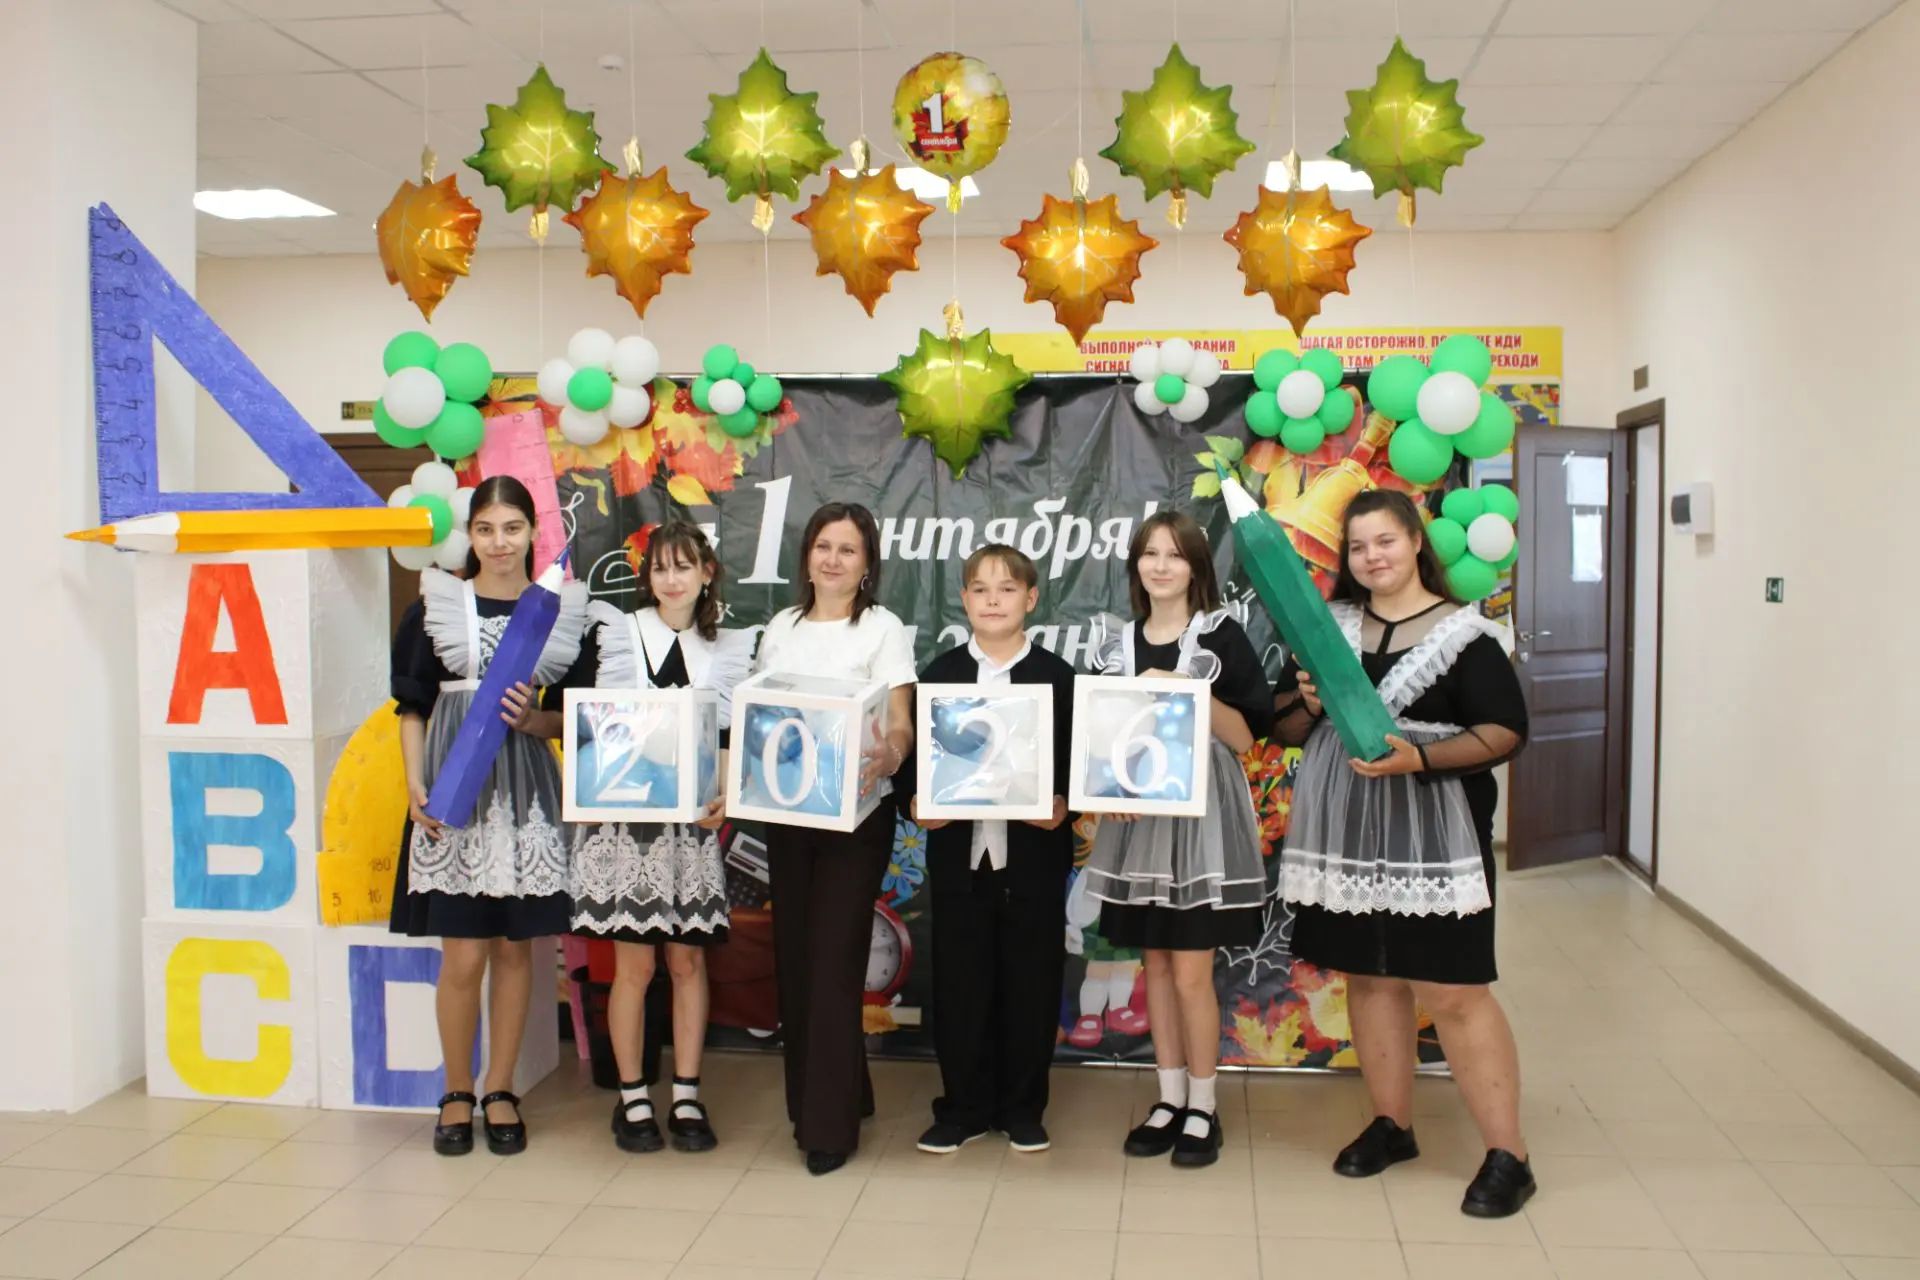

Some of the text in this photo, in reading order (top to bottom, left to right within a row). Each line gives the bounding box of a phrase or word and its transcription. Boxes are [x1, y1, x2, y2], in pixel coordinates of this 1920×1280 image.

[922, 92, 944, 133] 1
[115, 356, 143, 373] 5
[1300, 336, 1343, 349] ШАГАЯ
[1346, 335, 1428, 349] ОСТОРОЖНО,
[1495, 335, 1522, 349] ИДИ
[1490, 354, 1539, 369] РЕХОДИ
[121, 472, 147, 486] 2
[738, 475, 792, 584] 1
[166, 563, 288, 725] A
[595, 701, 1172, 806] 2 0 2 6
[168, 751, 297, 912] B
[165, 937, 292, 1098] C
[348, 945, 482, 1108] D
